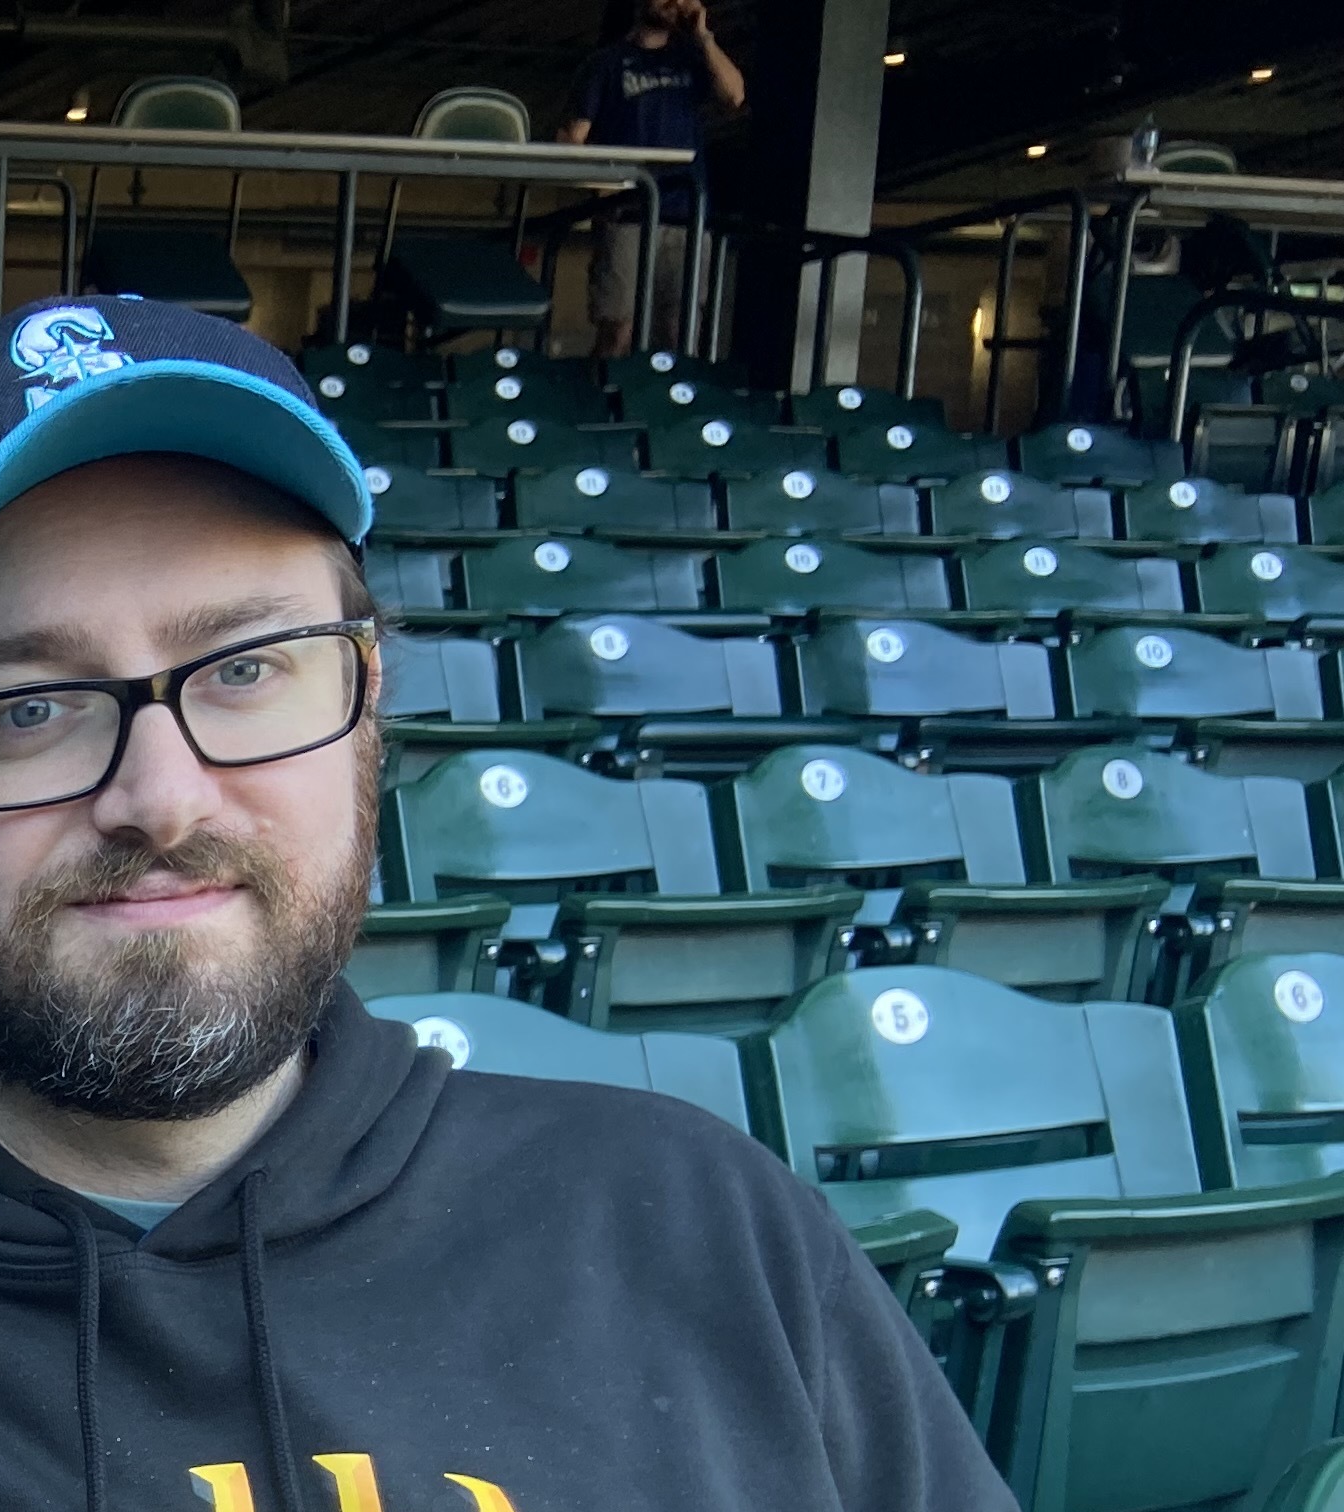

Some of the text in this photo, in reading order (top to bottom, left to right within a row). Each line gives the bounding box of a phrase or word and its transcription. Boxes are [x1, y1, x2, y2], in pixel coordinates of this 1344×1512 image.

[367, 476, 382, 487] 10
[586, 478, 597, 488] 11
[547, 550, 556, 562] 9
[794, 552, 810, 565] 10
[1034, 555, 1046, 569] 11
[1260, 560, 1273, 572] 12
[880, 638, 891, 654] 9
[1145, 643, 1164, 659] 10
[496, 775, 510, 799] 6
[815, 770, 826, 791] 7
[1117, 768, 1128, 790] 8
[1291, 985, 1307, 1011] 6
[890, 1004, 910, 1031] 5
